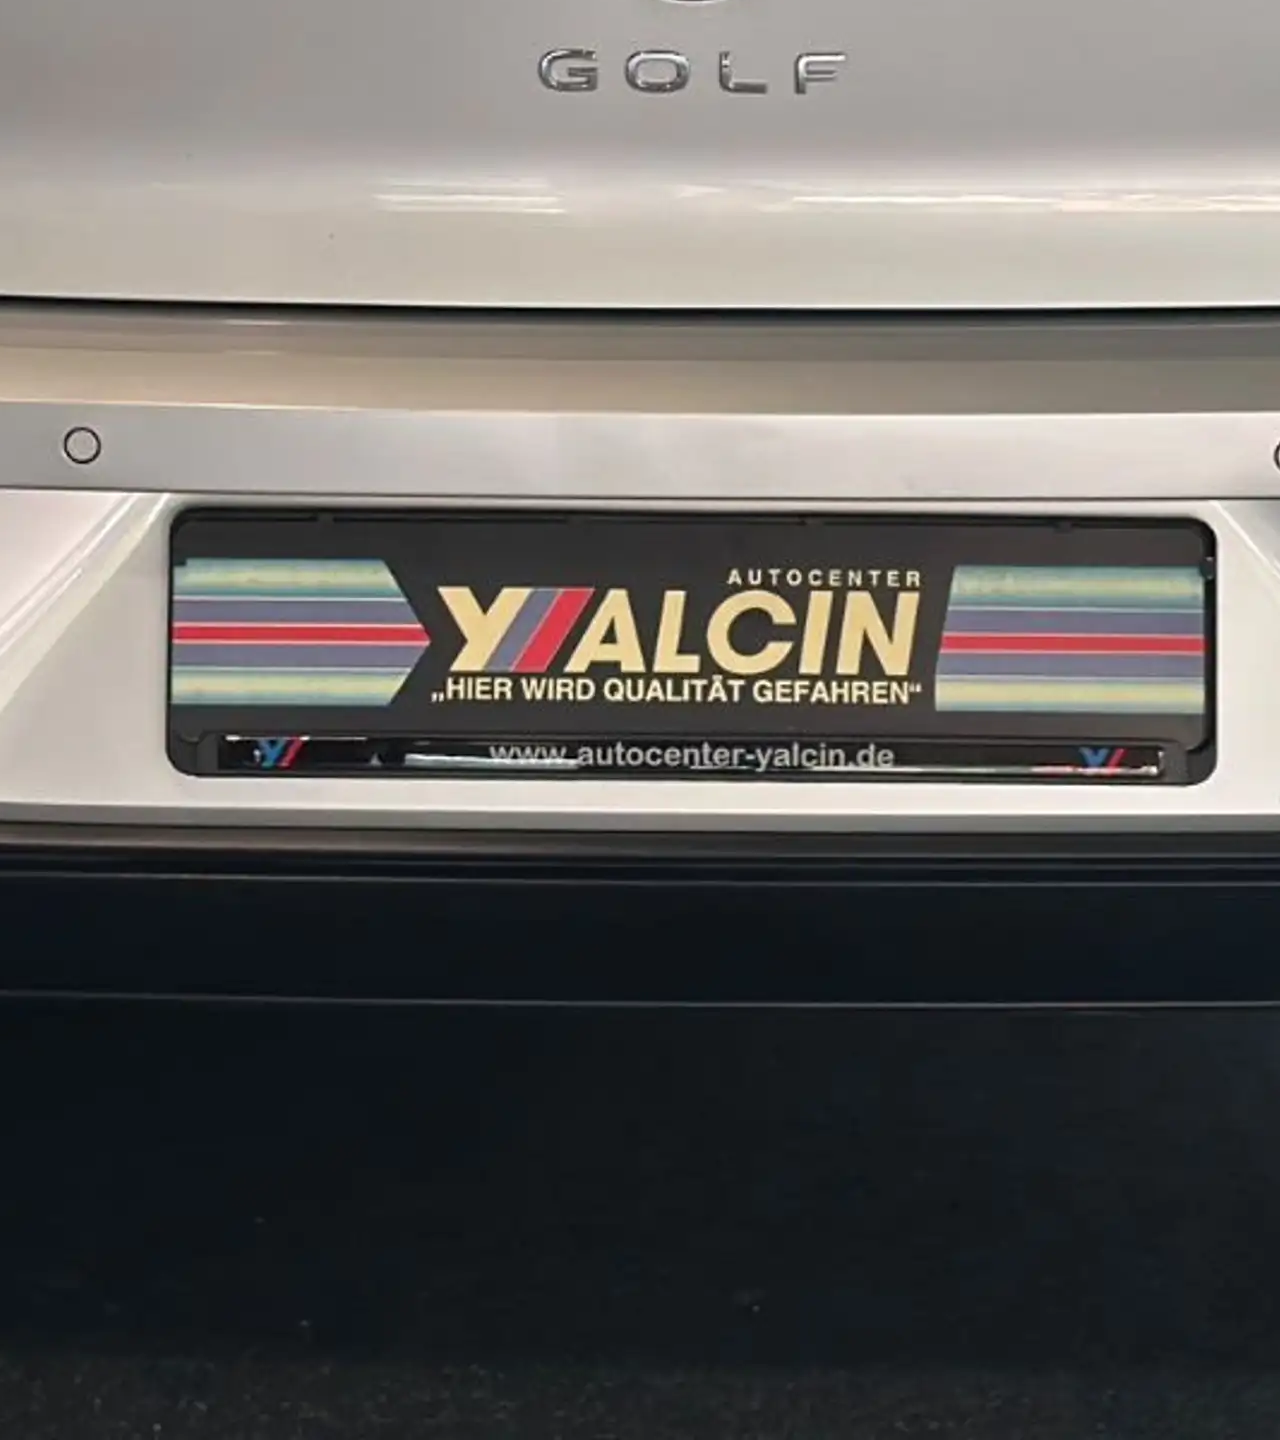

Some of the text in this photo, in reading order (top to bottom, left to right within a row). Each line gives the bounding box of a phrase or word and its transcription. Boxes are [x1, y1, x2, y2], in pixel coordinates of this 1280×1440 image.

[537, 48, 847, 95] GOLF
[726, 567, 921, 587] AUTOCENTER
[521, 678, 596, 703] WIRD
[603, 675, 748, 704] QUALITÄT
[488, 741, 896, 773] www.autocenter-yalcin.de
